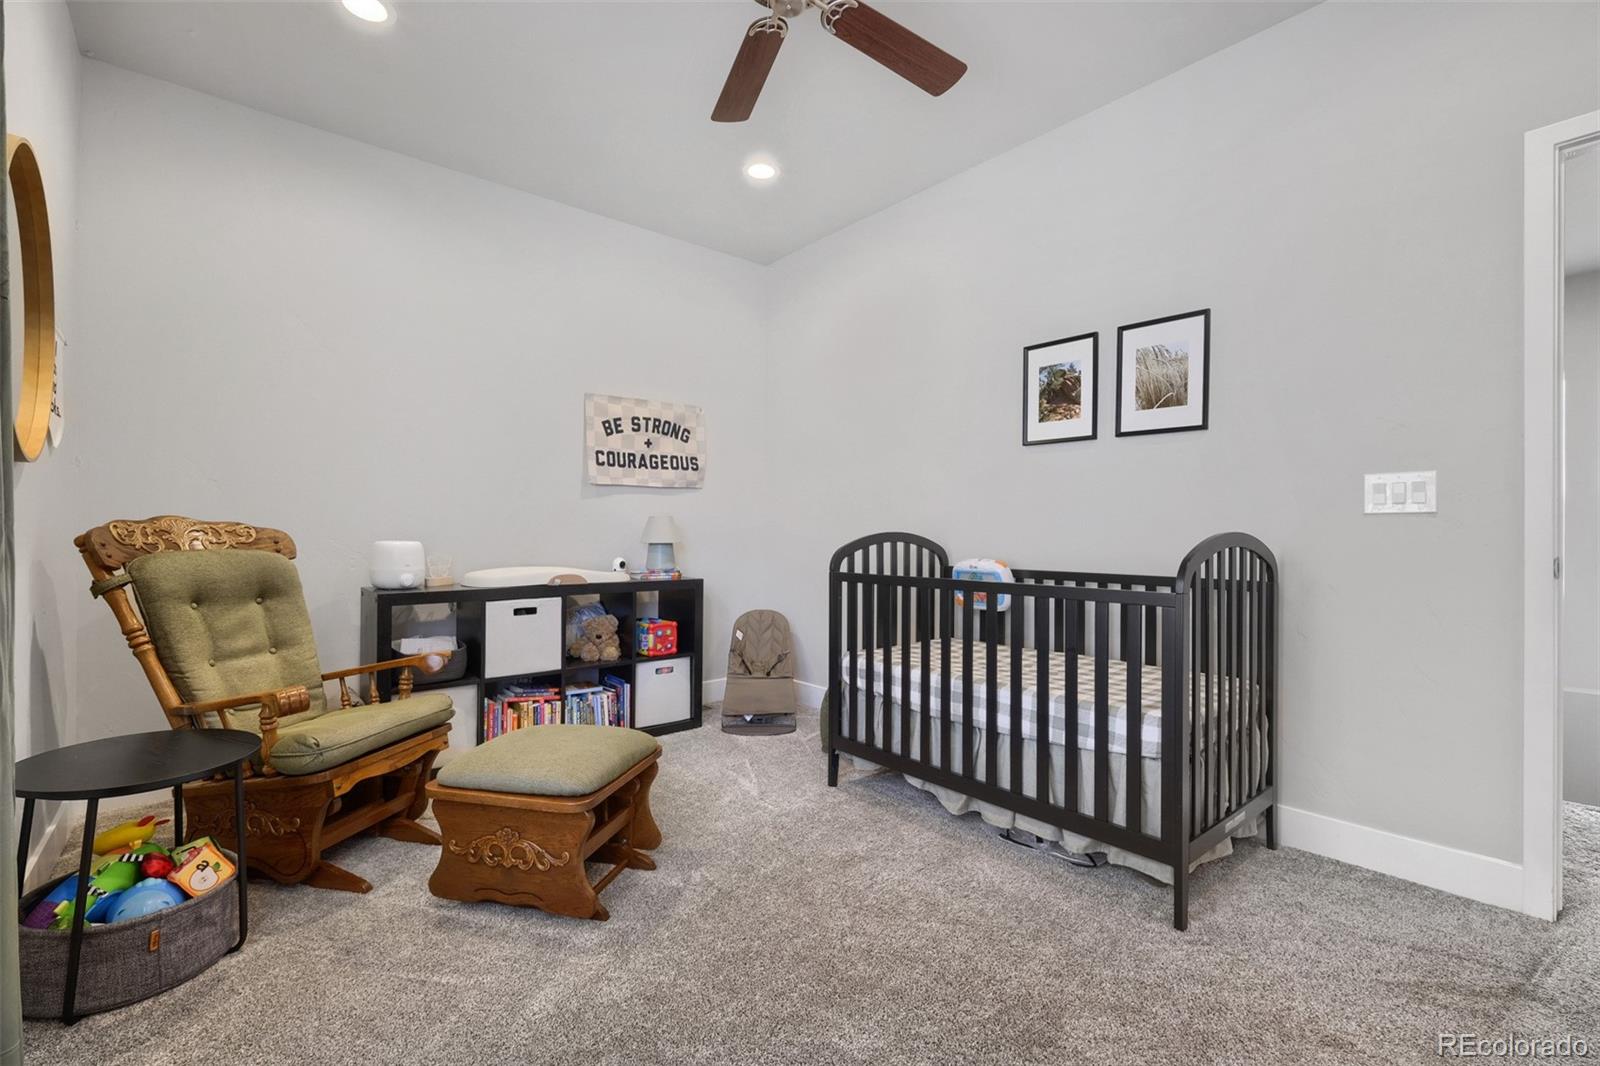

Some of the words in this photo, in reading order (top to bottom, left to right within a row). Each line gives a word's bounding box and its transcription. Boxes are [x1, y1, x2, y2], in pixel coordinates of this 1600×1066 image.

[602, 417, 624, 437] BE
[631, 416, 691, 443] STRONG
[595, 450, 699, 471] COURAGEOUS
[196, 859, 210, 873] a
